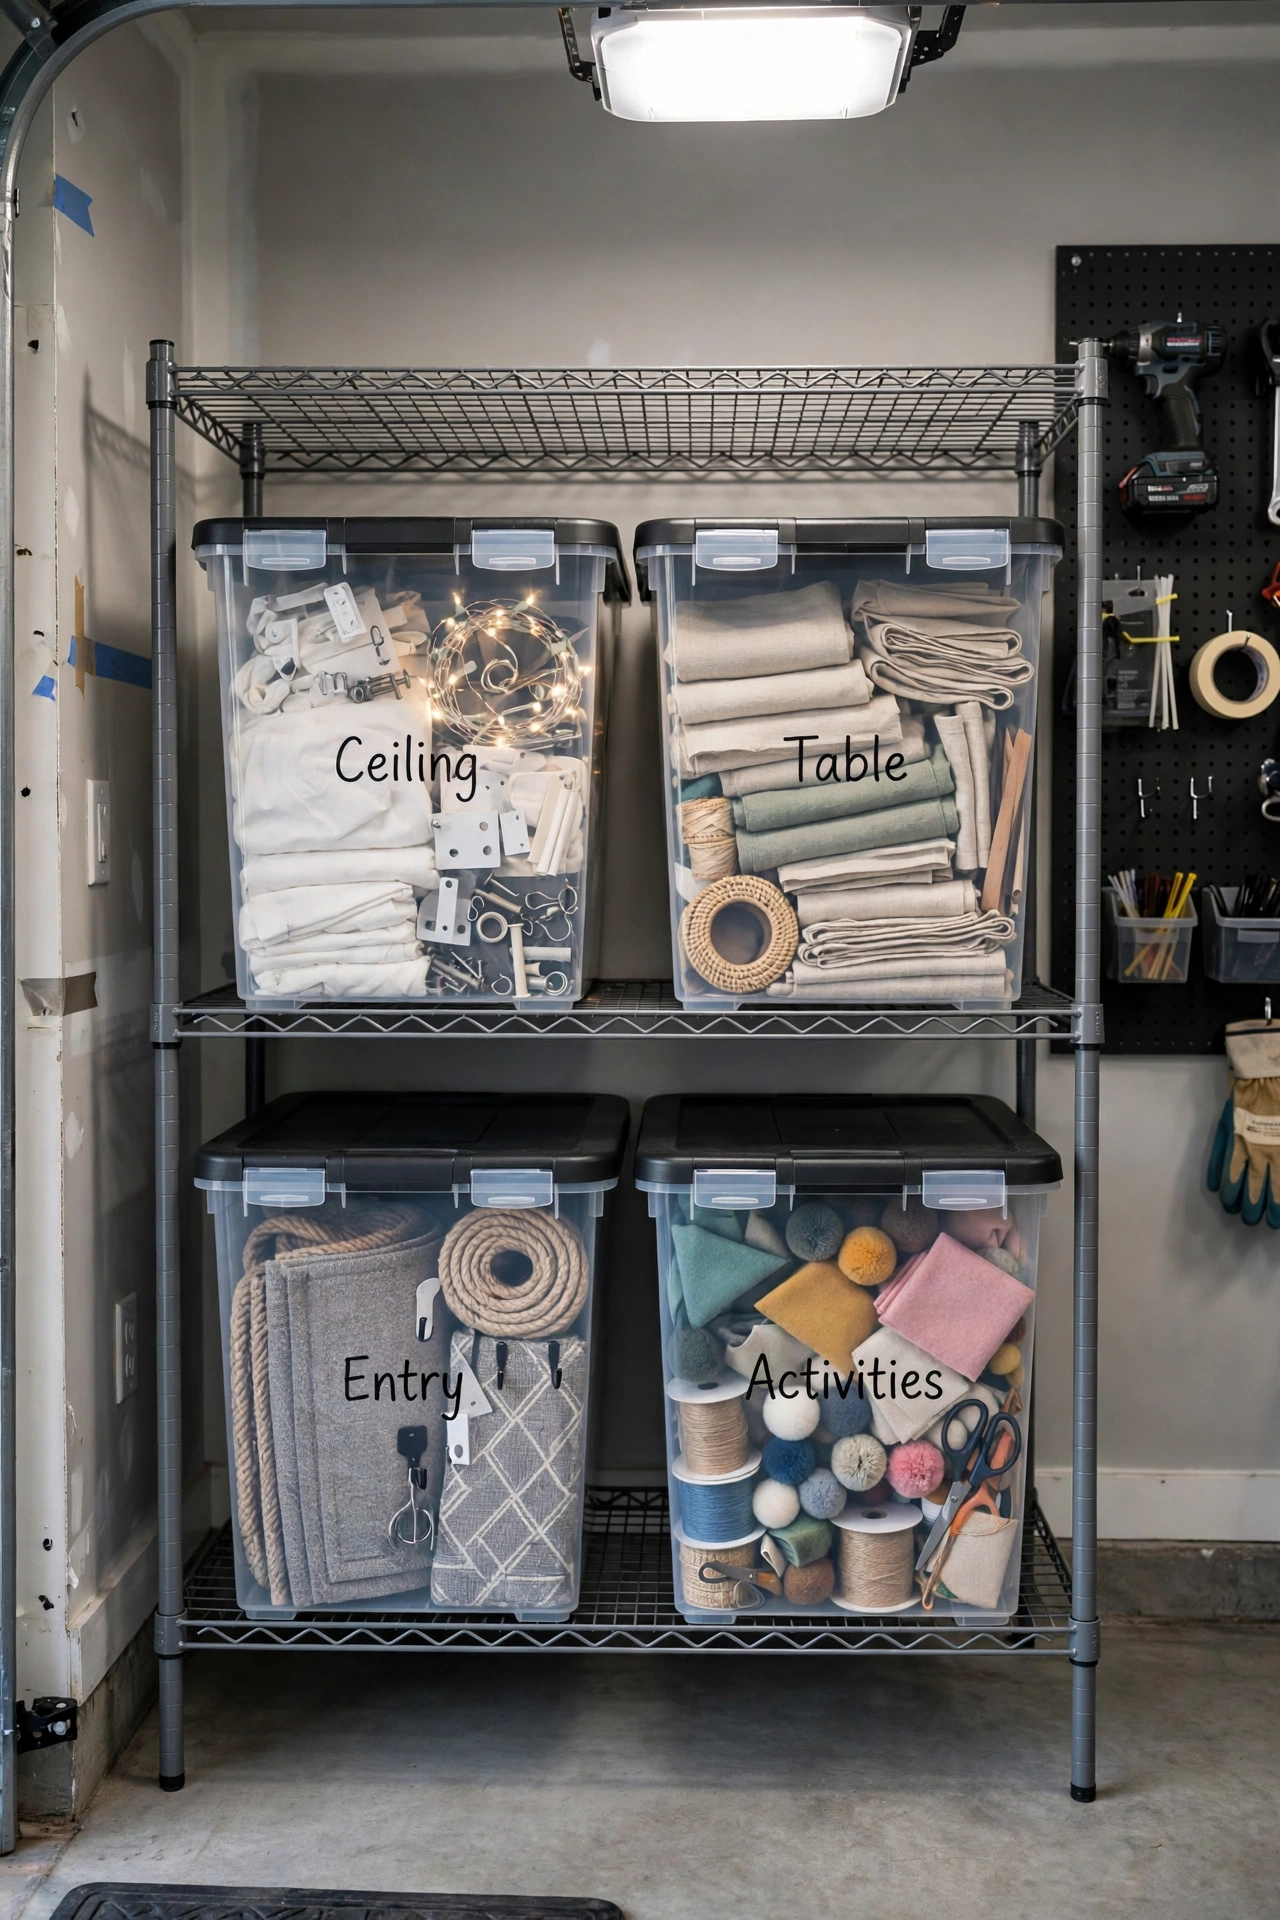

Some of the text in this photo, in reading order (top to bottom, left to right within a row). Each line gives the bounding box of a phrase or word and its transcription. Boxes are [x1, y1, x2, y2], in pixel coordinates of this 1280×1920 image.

[336, 734, 478, 803] Ceiling
[783, 734, 908, 783] Table
[344, 1355, 463, 1421] Entry
[745, 1353, 944, 1401] Activities
